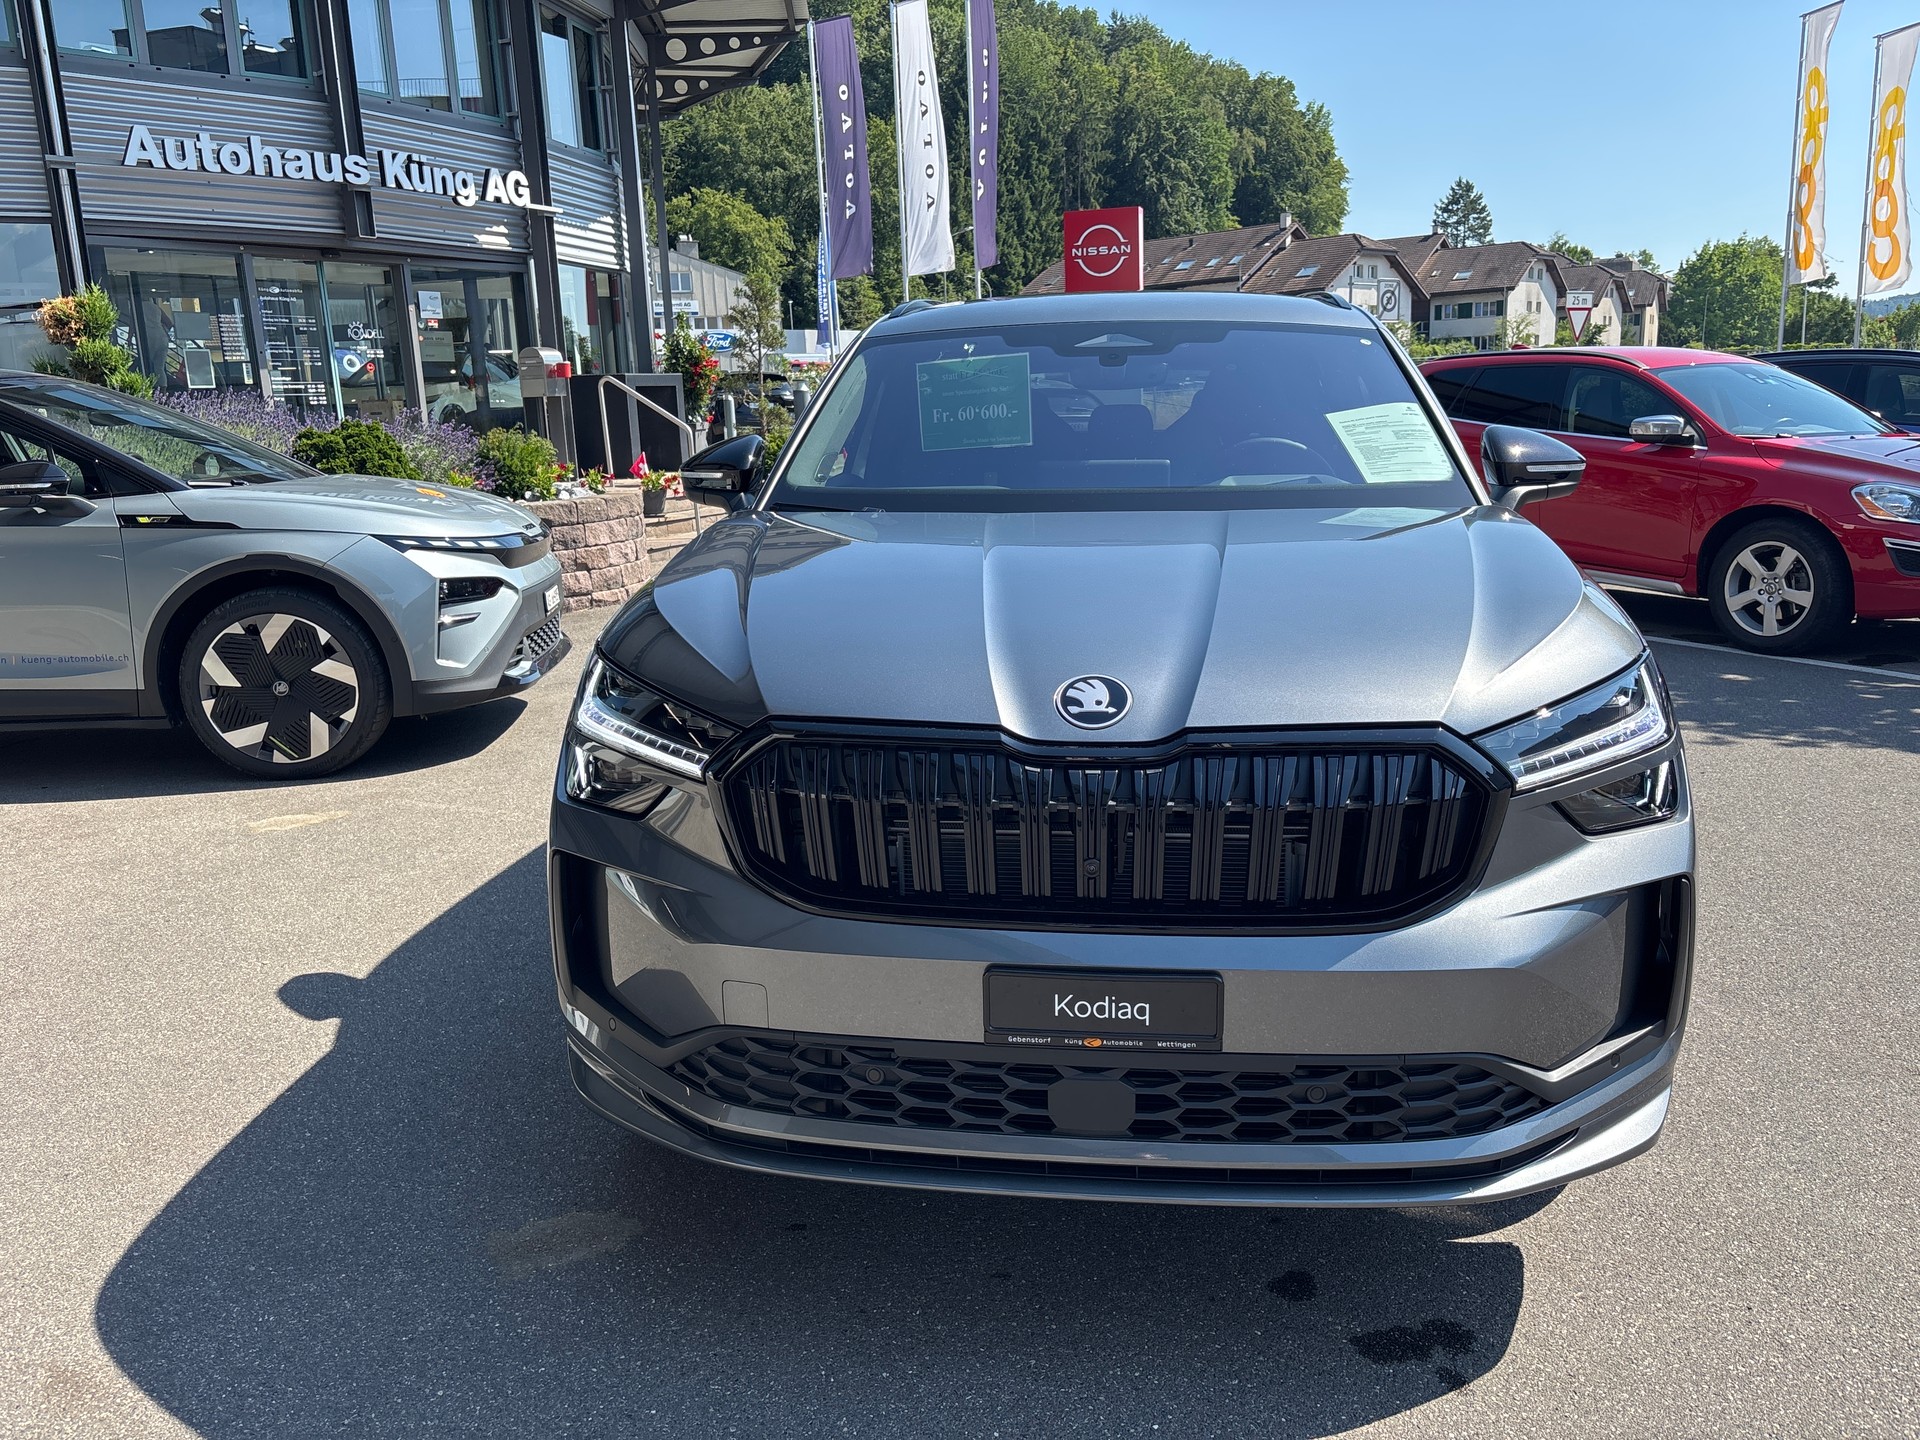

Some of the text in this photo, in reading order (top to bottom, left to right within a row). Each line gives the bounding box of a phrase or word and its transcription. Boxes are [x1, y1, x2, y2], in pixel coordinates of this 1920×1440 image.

[918, 70, 936, 212] VOLVO
[838, 84, 856, 219] VOLVO
[122, 124, 531, 207] Autohaus Küng AG
[1867, 85, 1905, 280] coop
[1071, 244, 1131, 257] NISSAN
[1572, 295, 1580, 305] 25
[704, 334, 731, 347] Ford
[932, 408, 954, 423] Fr.
[21, 653, 130, 665] kueng-automobile.ch
[1053, 993, 1150, 1026] Kodiaq
[1007, 1035, 1197, 1049] Gebenstorf Küng Automobile Wettingen
